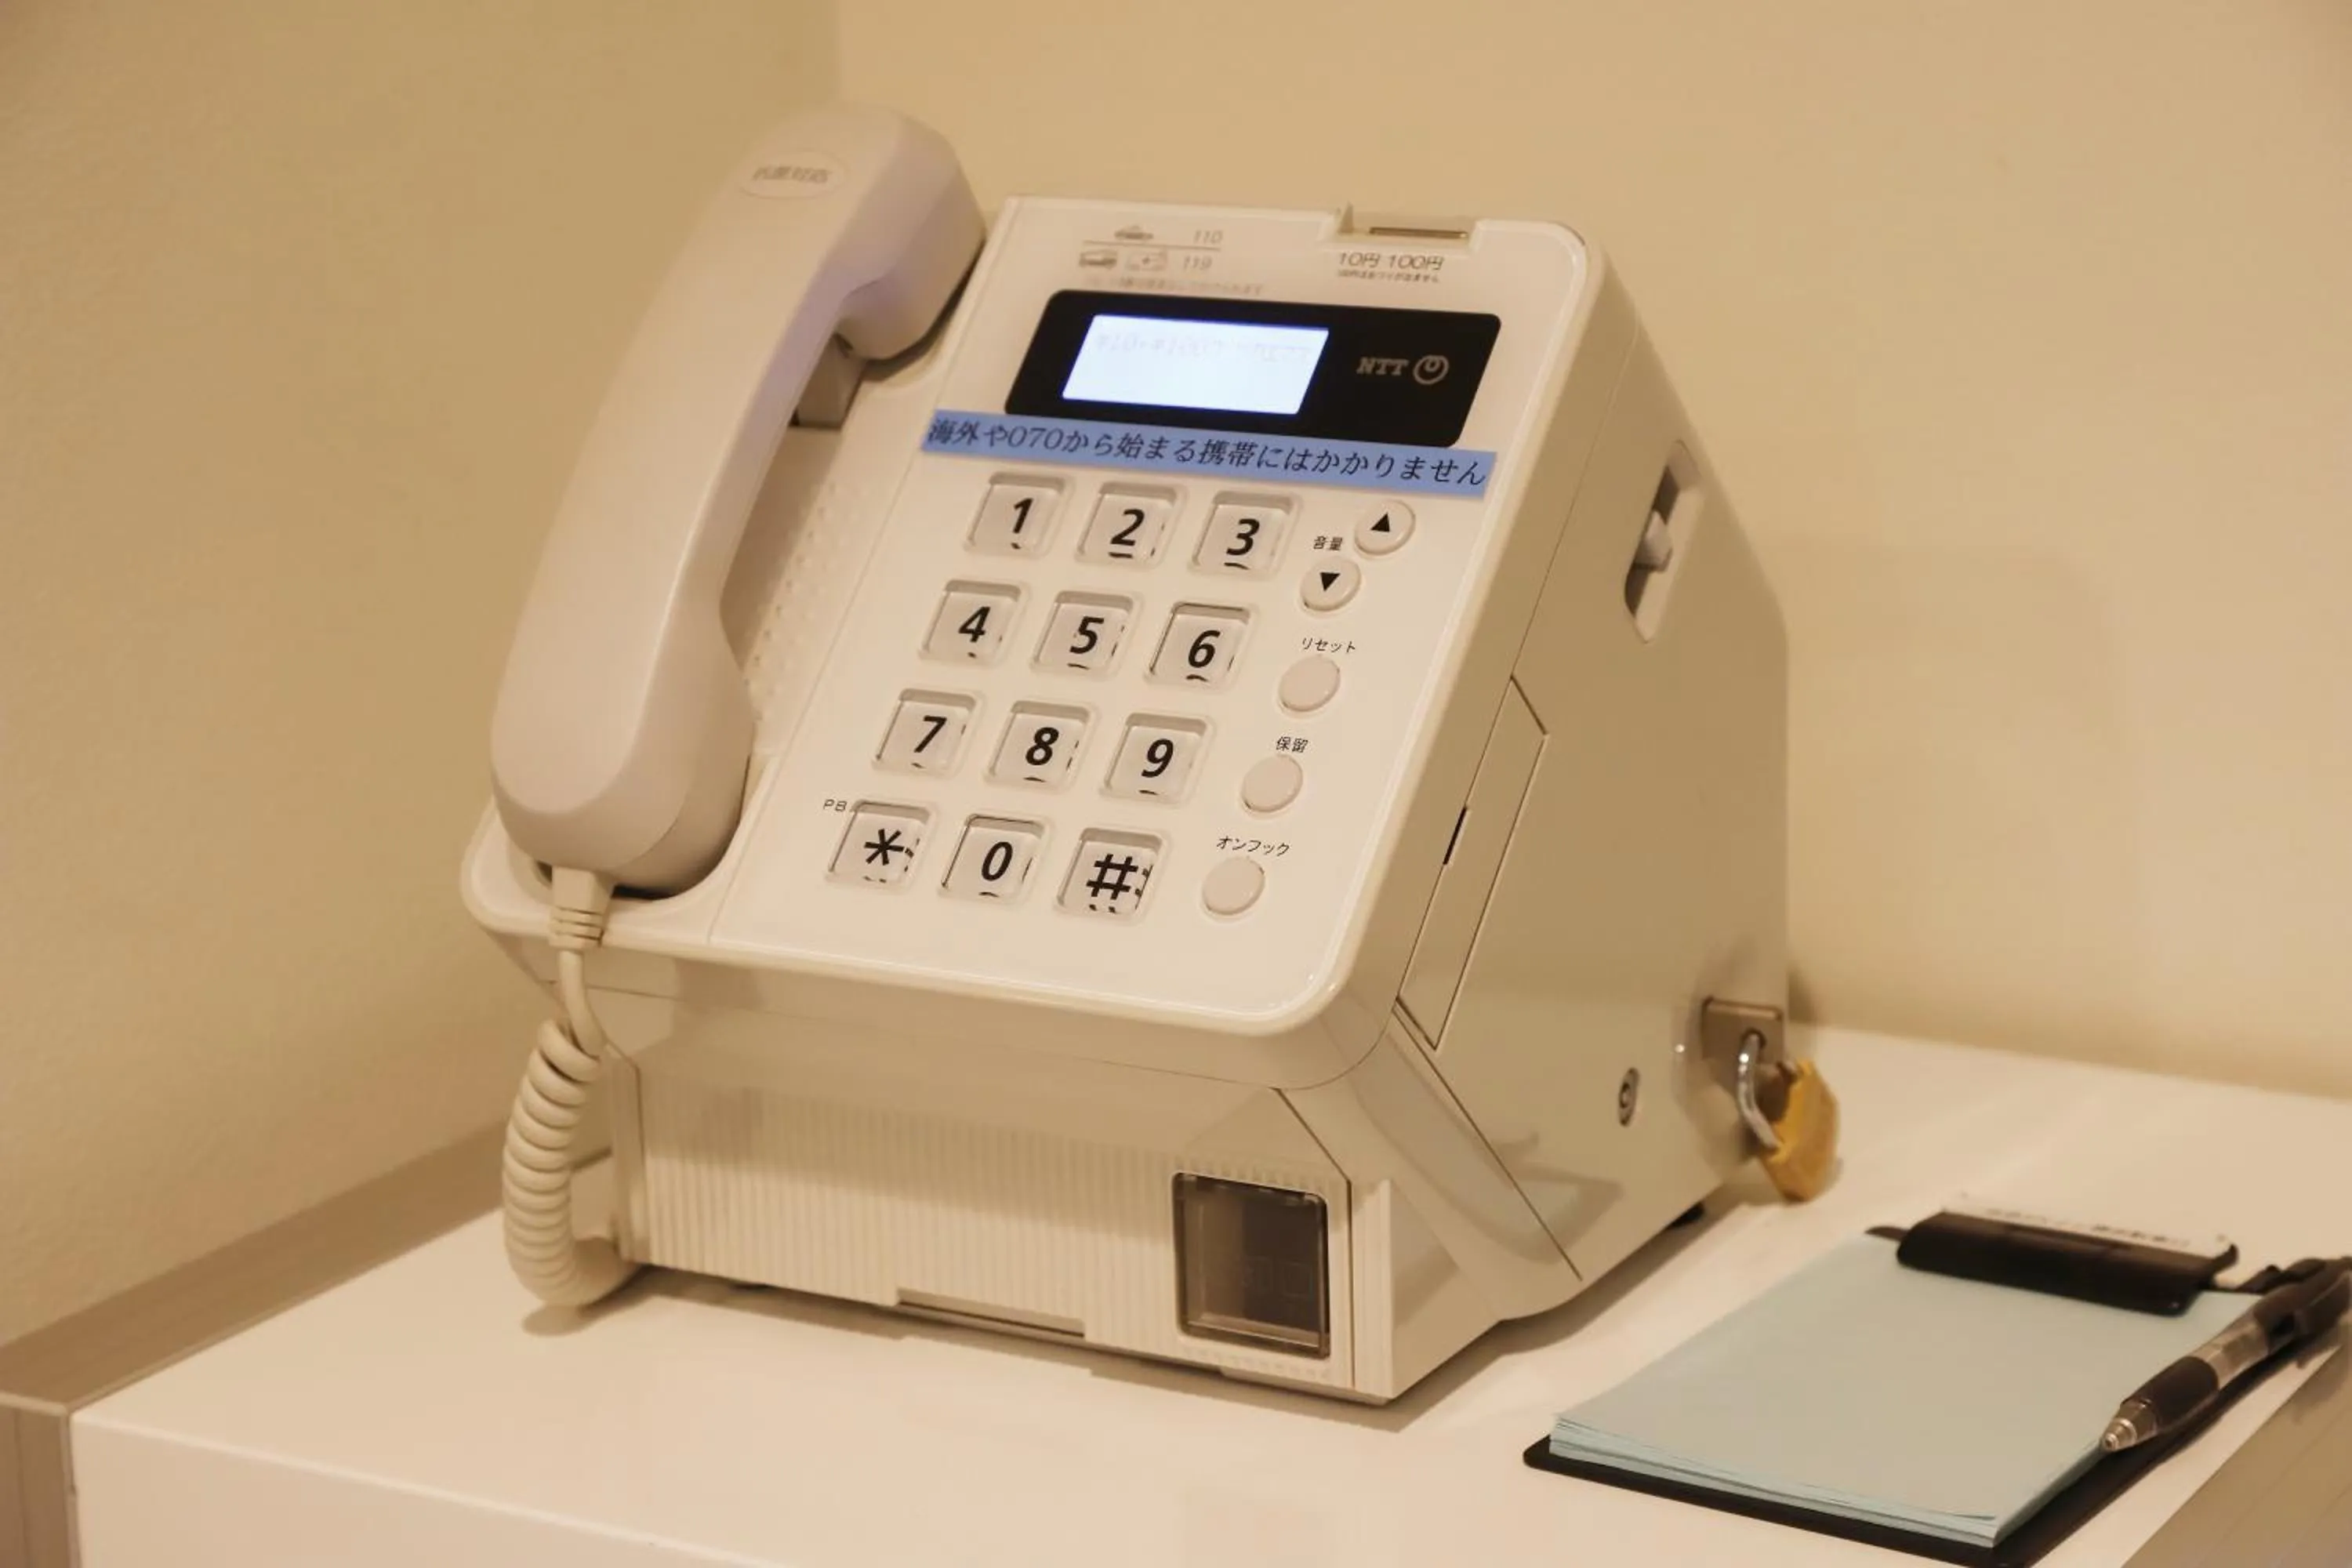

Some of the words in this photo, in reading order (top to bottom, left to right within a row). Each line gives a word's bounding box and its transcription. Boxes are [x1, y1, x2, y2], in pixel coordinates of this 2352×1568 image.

[1192, 229, 1223, 245] 110
[1339, 252, 1381, 268] 10円
[1388, 254, 1444, 271] 100円
[1356, 357, 1408, 377] NTT
[1011, 497, 1035, 535] 1
[1110, 508, 1145, 546] 2
[1225, 517, 1261, 556] 3
[1312, 535, 1343, 551] 音量
[957, 605, 991, 643] 4
[1069, 615, 1105, 655] 5
[1187, 630, 1221, 669] 6
[1301, 637, 1356, 654] リセット
[913, 715, 948, 753] 7
[1025, 726, 1059, 766] 8
[1276, 735, 1308, 753] 保留
[1141, 738, 1174, 779] 9
[822, 798, 848, 812] PB
[981, 840, 1014, 882] 0
[1216, 835, 1291, 857] オンフック
